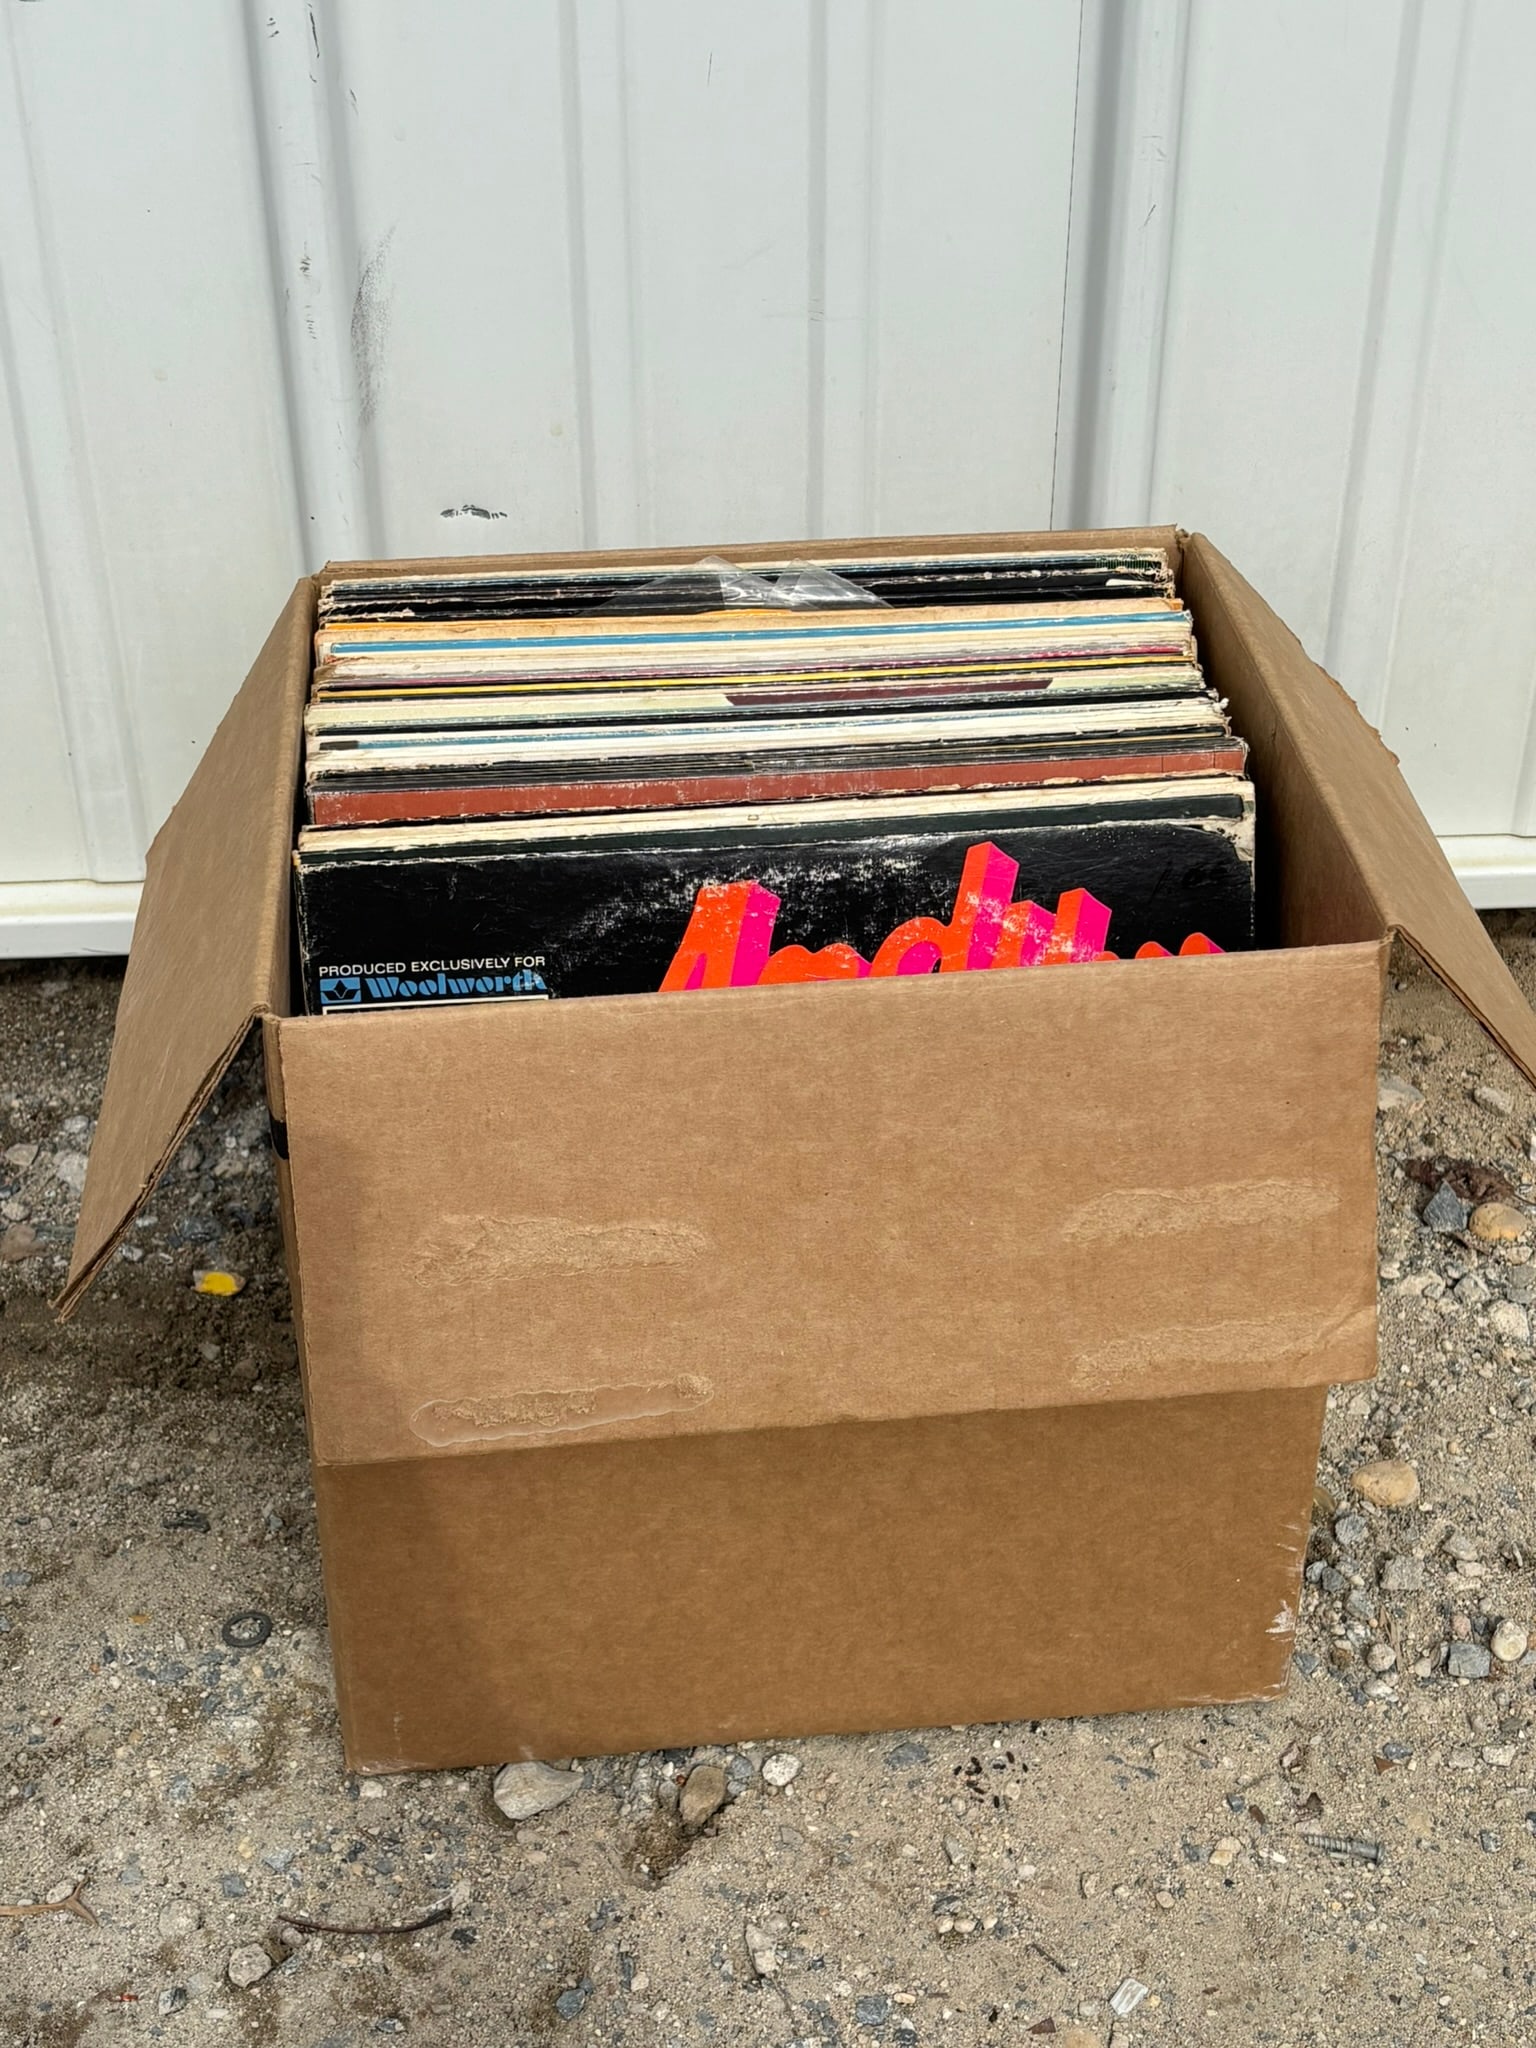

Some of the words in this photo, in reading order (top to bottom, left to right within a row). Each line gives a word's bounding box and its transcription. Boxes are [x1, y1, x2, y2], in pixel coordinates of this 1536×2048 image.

[319, 962, 406, 977] PRODUCED
[411, 957, 510, 972] EXCLUSIVELY
[514, 956, 546, 967] FOR
[365, 969, 548, 998] Woolworth
